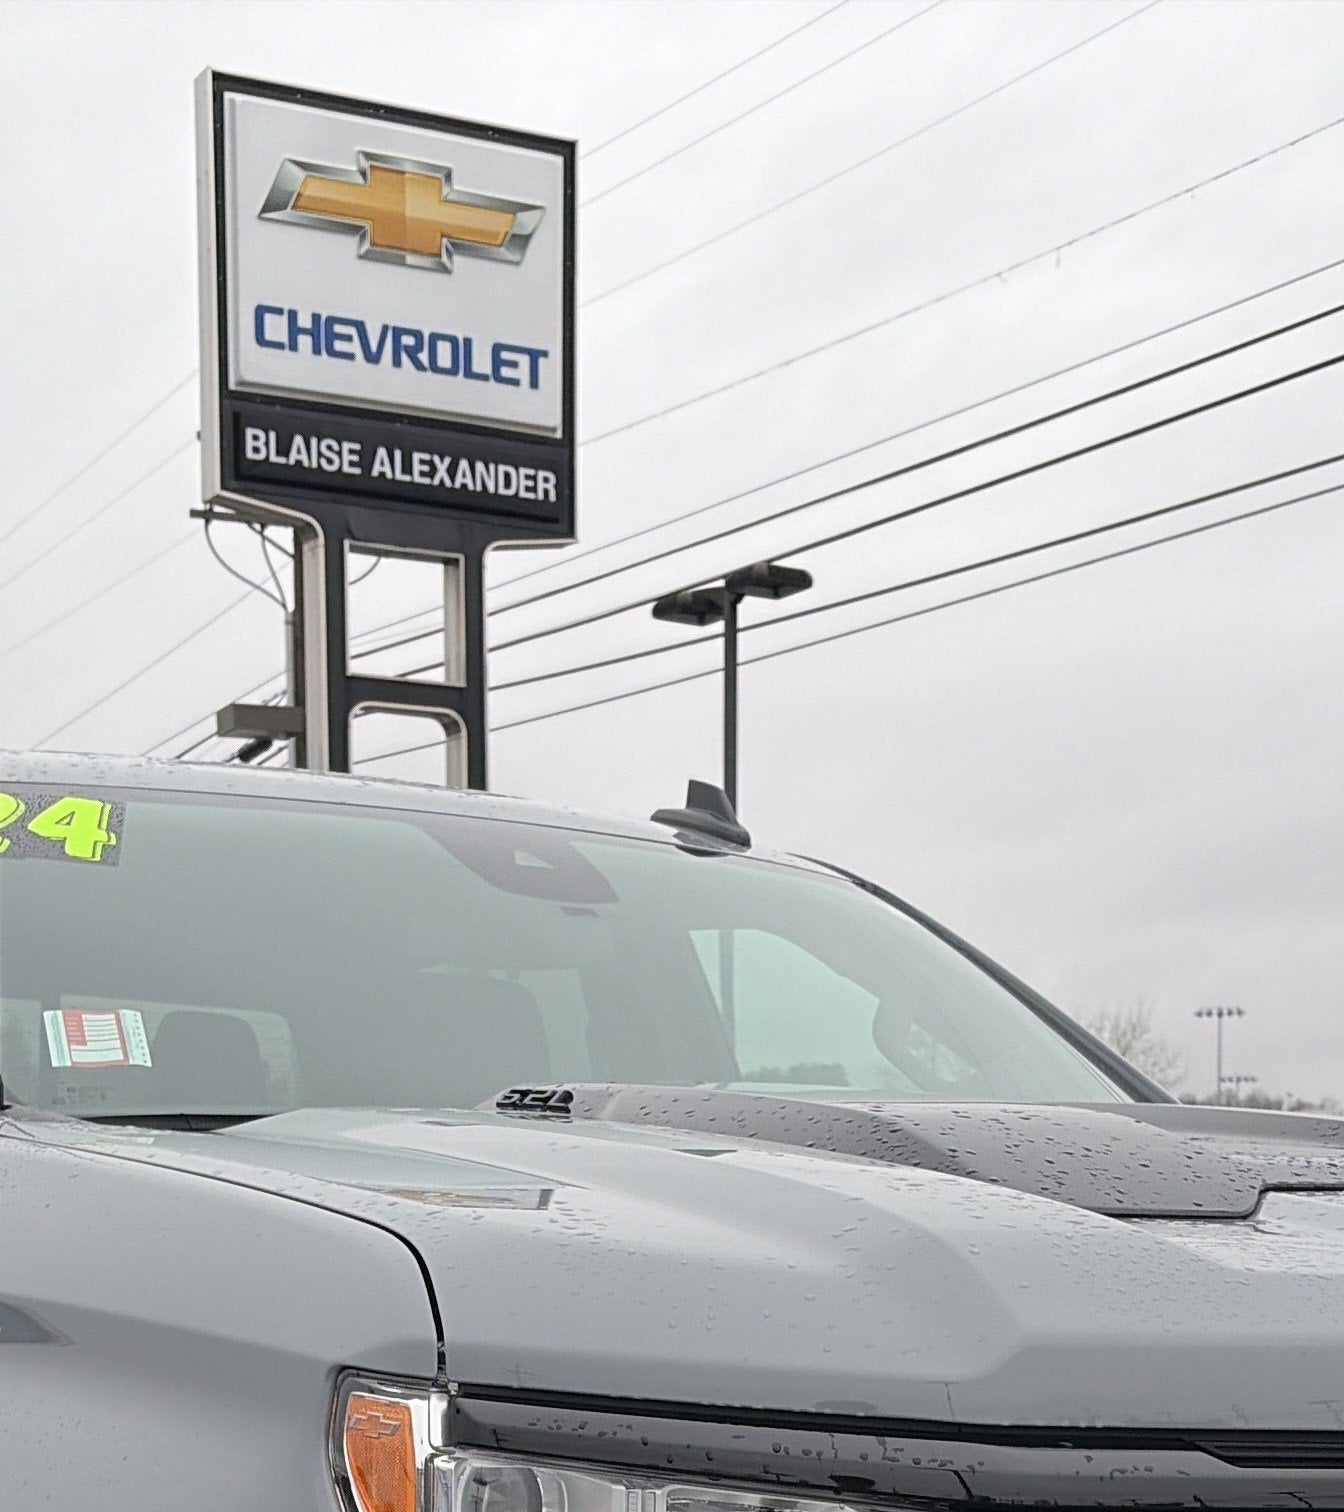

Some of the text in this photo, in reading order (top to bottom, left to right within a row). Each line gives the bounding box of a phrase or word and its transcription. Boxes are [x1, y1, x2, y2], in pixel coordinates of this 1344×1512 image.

[254, 304, 549, 390] CHEVROLET
[244, 426, 557, 503] BLAISE ALEXANDER
